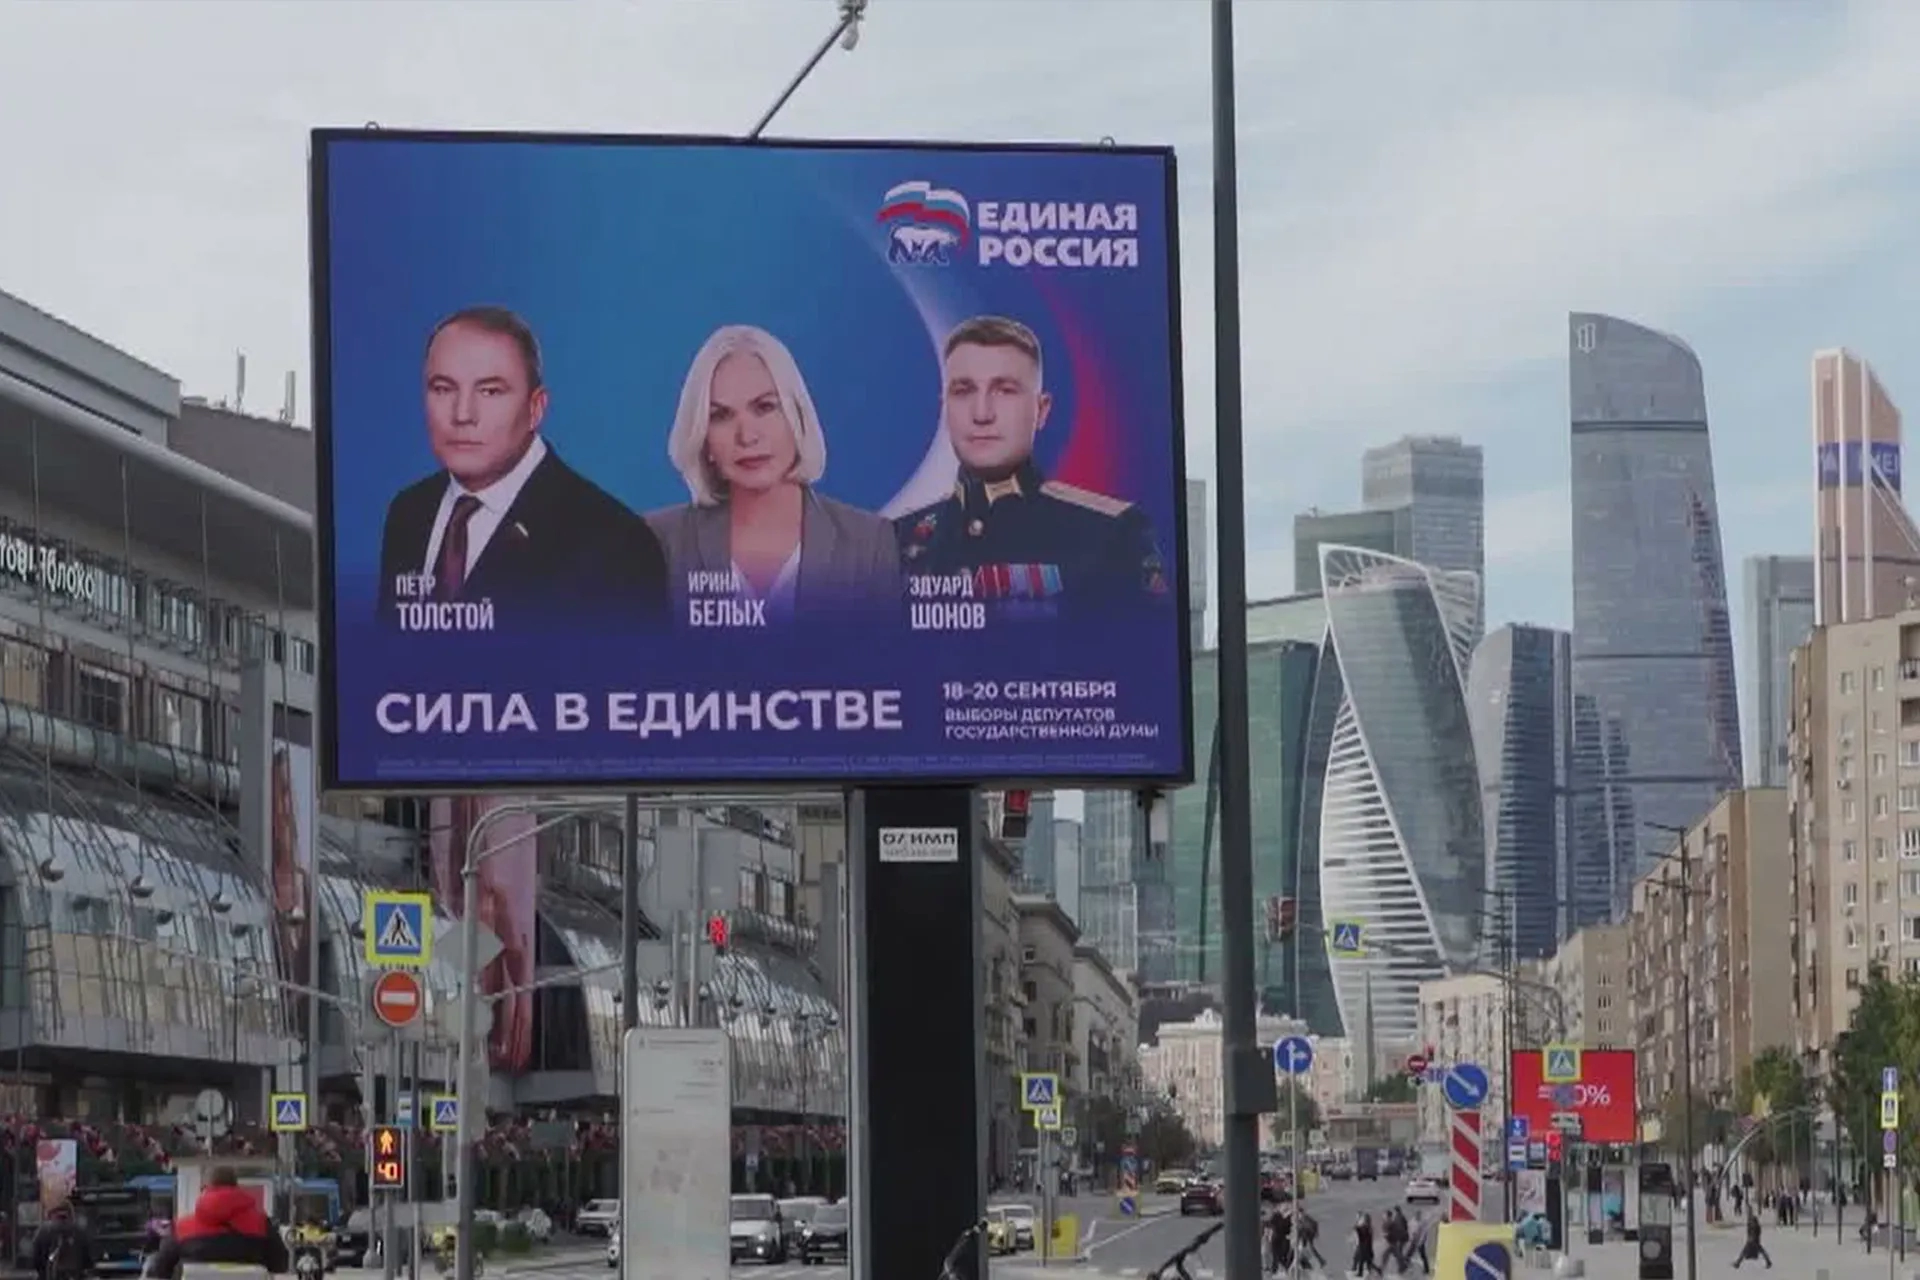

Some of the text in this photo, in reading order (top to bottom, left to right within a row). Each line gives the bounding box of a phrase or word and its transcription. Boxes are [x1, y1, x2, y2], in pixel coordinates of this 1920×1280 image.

[978, 202, 1138, 232] ЕДИНАЯ
[979, 238, 1139, 267] РОССИЯ
[688, 571, 741, 593] ИРИНА
[910, 574, 974, 598] ЭДУАРД
[396, 597, 495, 631] ТОЛСТОЙ
[689, 599, 766, 627] БЕЛЫХ
[911, 602, 986, 630] ШОНОВ
[1004, 681, 1117, 700] СЕНТЯБРЯ
[376, 689, 903, 739] СИЛА В ЕДИНСТВЕ
[945, 707, 1115, 722] ВЫБОРЫ ДЕПУТАТОВ
[945, 724, 1159, 740] ГОСУДАРСТВЕННОЙ ДУМЫ
[377, 1162, 399, 1181] 40
